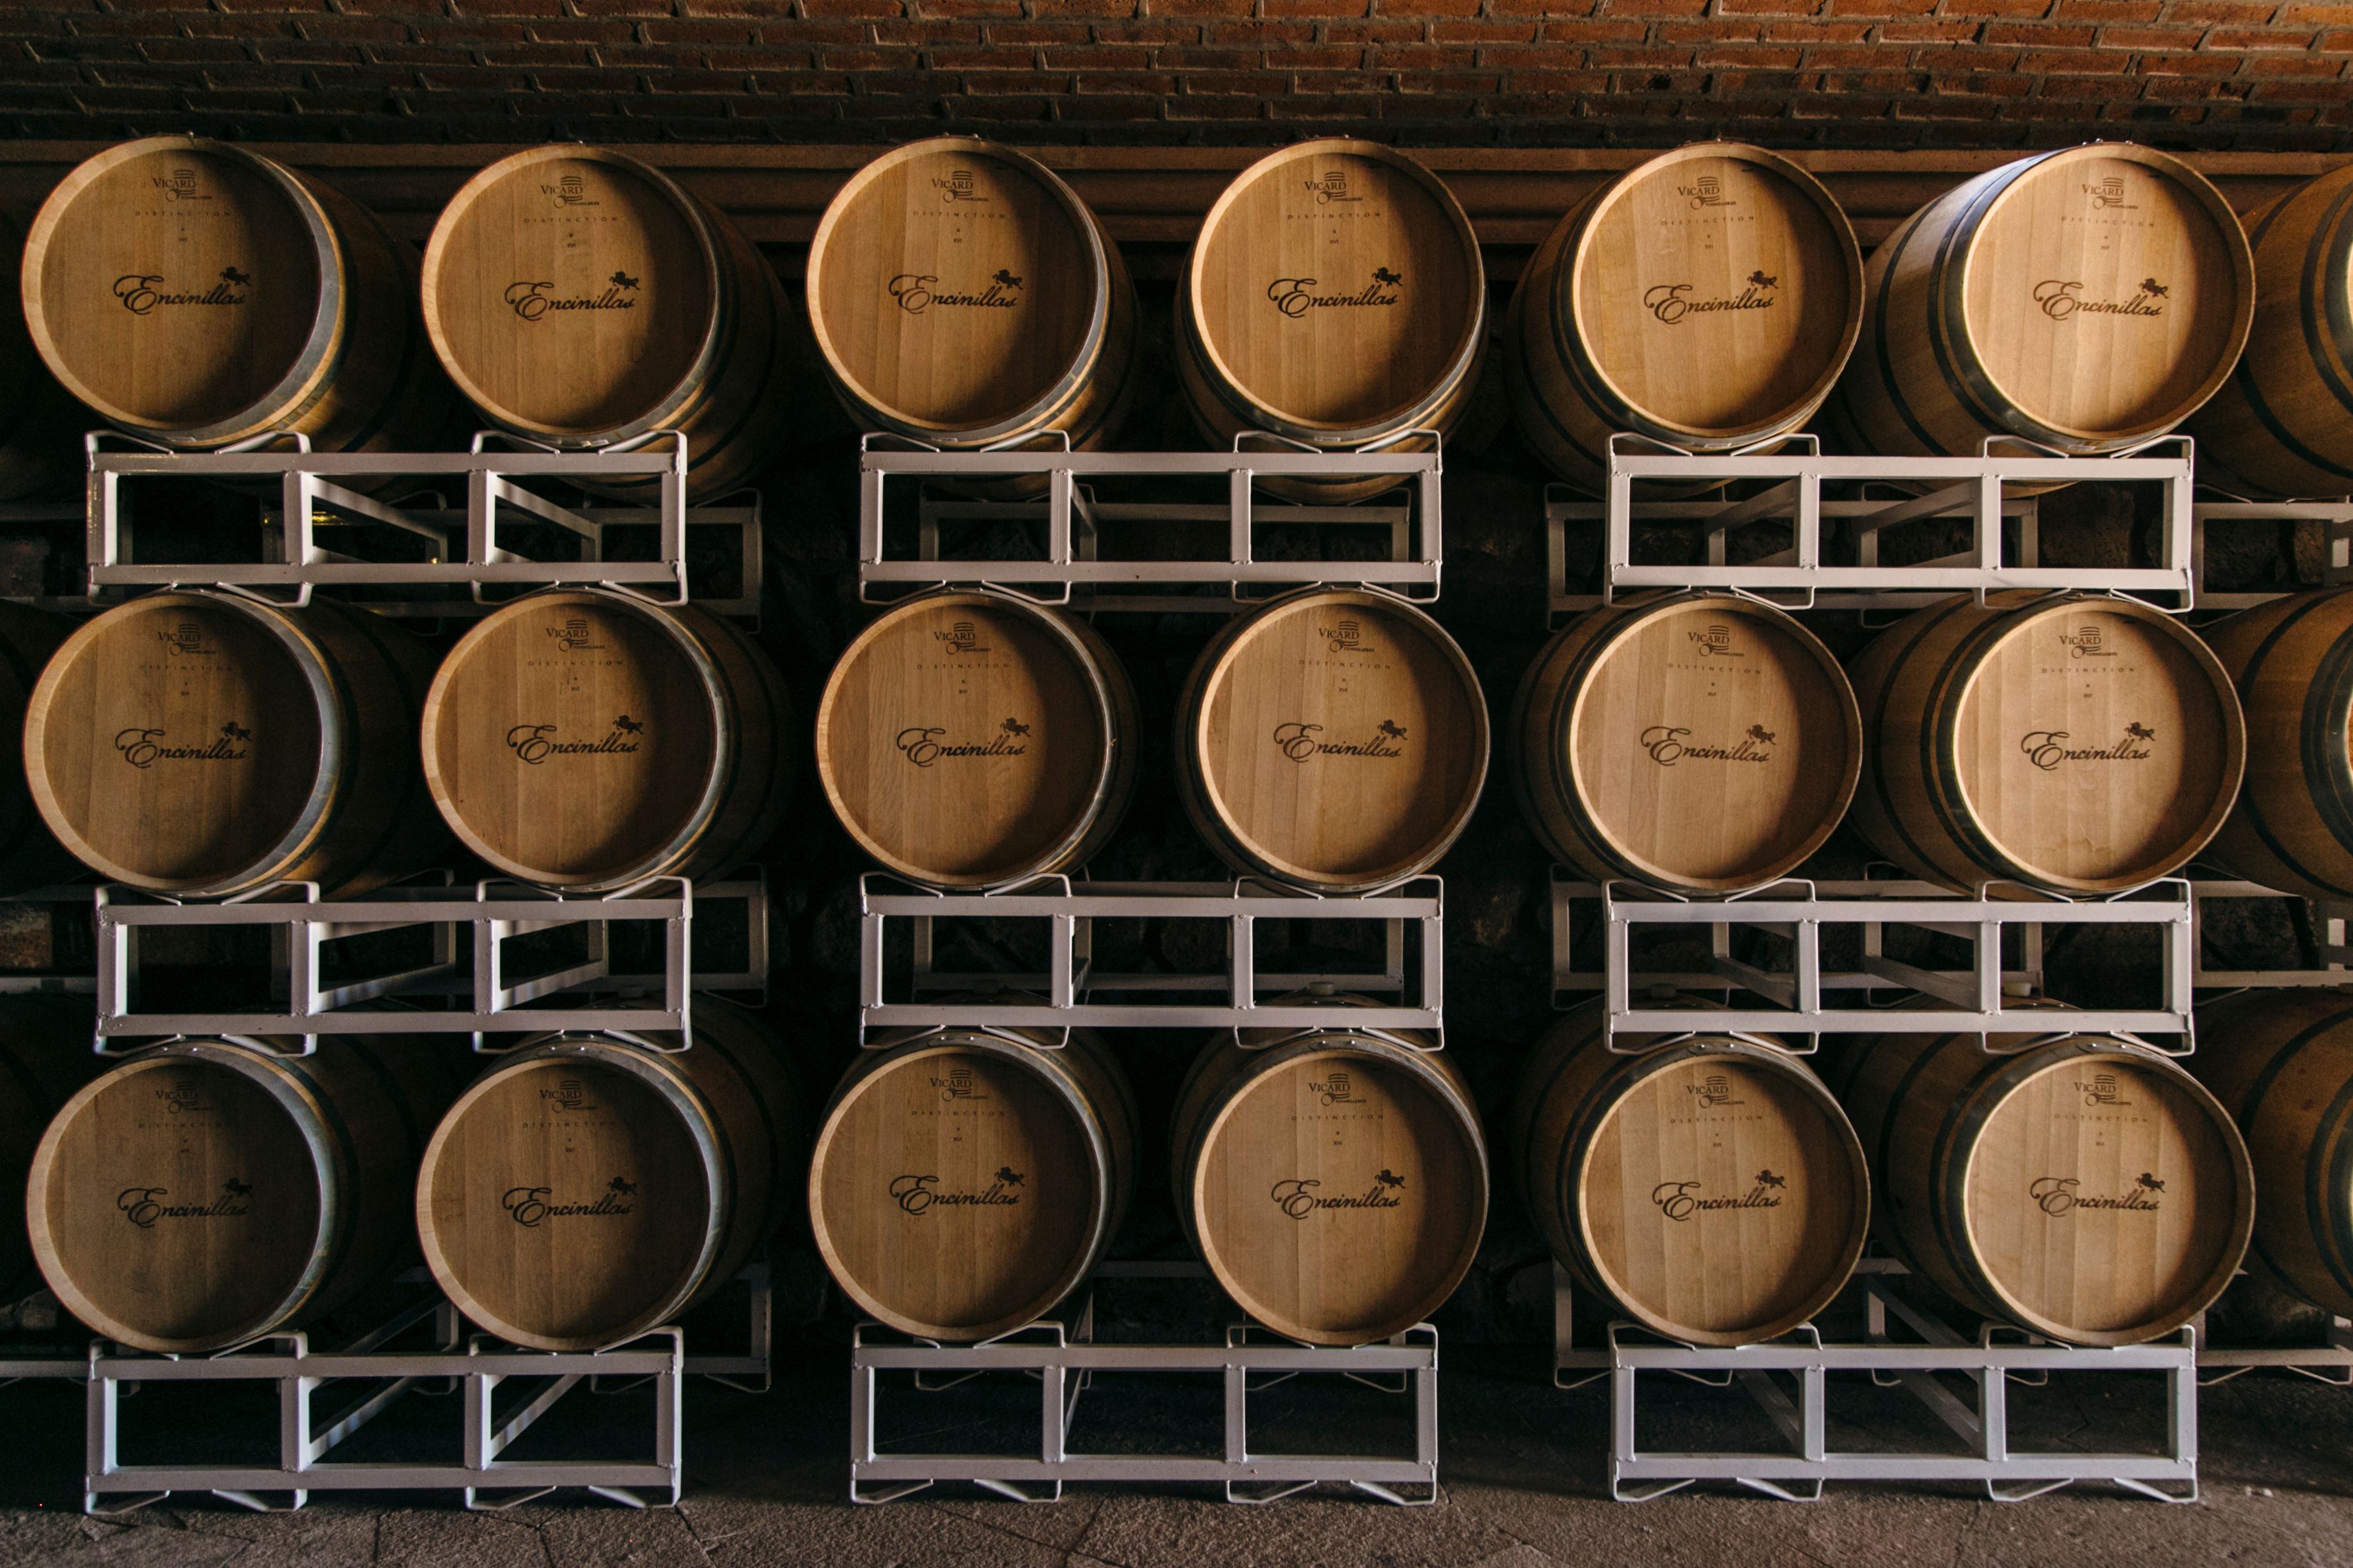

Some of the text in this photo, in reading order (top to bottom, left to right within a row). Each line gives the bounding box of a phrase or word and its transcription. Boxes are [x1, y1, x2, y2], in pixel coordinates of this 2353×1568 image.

[154, 178, 195, 188] VICARD
[932, 178, 973, 189] VICARD
[1305, 181, 1347, 190] VICARD
[541, 185, 582, 194] VICARD
[1678, 185, 1719, 196] VICARD
[2083, 184, 2123, 196] VICARD
[1662, 216, 1754, 226] DISTINCTION
[2061, 217, 2154, 227] DISTINCTION
[114, 276, 246, 314] Encinillas
[889, 275, 1017, 314] Encinillas
[1268, 279, 1398, 318] Encinillas
[505, 282, 636, 321] Encinillas
[1645, 285, 1774, 324] Encinillas
[2033, 281, 2162, 320] Encinillas
[159, 632, 199, 642] VICARD
[547, 628, 588, 638] VICARD
[934, 632, 975, 640] VICARD
[1318, 628, 1359, 639] VICARD
[1689, 632, 1729, 644] VICARD
[2060, 635, 2101, 645] VICARD
[1299, 660, 1391, 669] DISTINCTION
[1668, 664, 1760, 674] DISTINCTION
[507, 726, 639, 764] Encinillas
[897, 728, 1026, 767] Encinillas
[1274, 723, 1401, 762] Encinillas
[1641, 726, 1769, 766] Encinillas
[115, 729, 246, 768] Encinillas
[2021, 732, 2150, 770] Encinillas
[930, 1078, 972, 1088] VICARD
[1309, 1083, 1350, 1092] VICARD
[2075, 1082, 2116, 1093] VICARD
[540, 1090, 582, 1099] VICARD
[1687, 1085, 1728, 1094] VICARD
[156, 1091, 198, 1100] VICARD
[889, 1176, 1019, 1215] Encinillas
[1272, 1180, 1400, 1219] Encinillas
[2030, 1177, 2159, 1216] Encinillas
[118, 1188, 249, 1227] Encinillas
[503, 1188, 633, 1227] Encinillas
[1652, 1183, 1781, 1221] Encinillas
